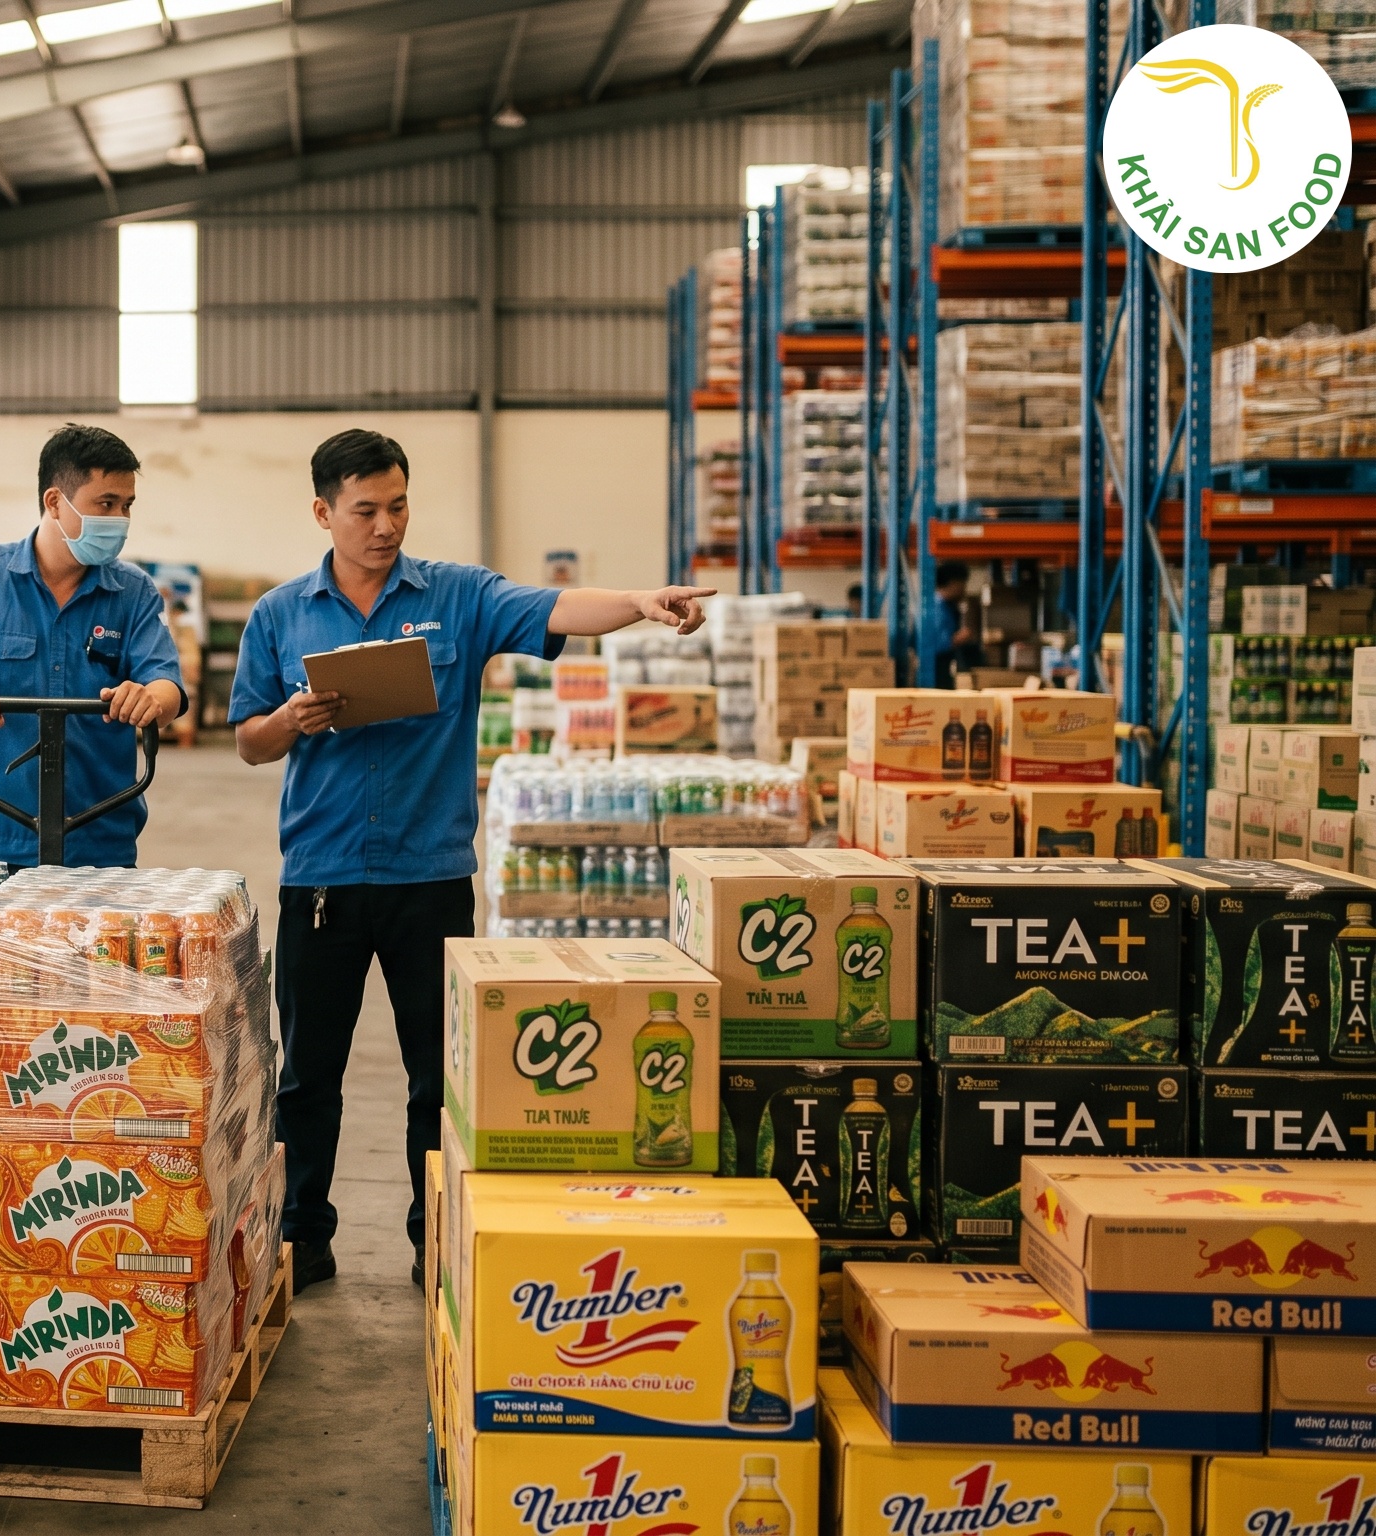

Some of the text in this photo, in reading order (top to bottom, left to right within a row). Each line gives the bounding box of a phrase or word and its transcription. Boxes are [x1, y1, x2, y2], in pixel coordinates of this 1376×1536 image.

[739, 907, 817, 973] C2
[842, 943, 885, 979] C2
[971, 917, 1146, 964] TEA+
[4, 1028, 141, 1106] MIRINDA
[513, 1013, 602, 1088] C2
[638, 1050, 687, 1094] C2
[979, 1101, 1156, 1147] TEA+
[10, 1168, 145, 1241] MIRINDA
[513, 1250, 681, 1349] Number 1
[1212, 1301, 1342, 1330] Red Bull
[0, 1301, 135, 1372] MIRINDA
[1013, 1414, 1140, 1444] Red Bull
[514, 1473, 682, 1534] Number
[583, 1455, 623, 1536] 1
[884, 1464, 1055, 1536] Number 1
